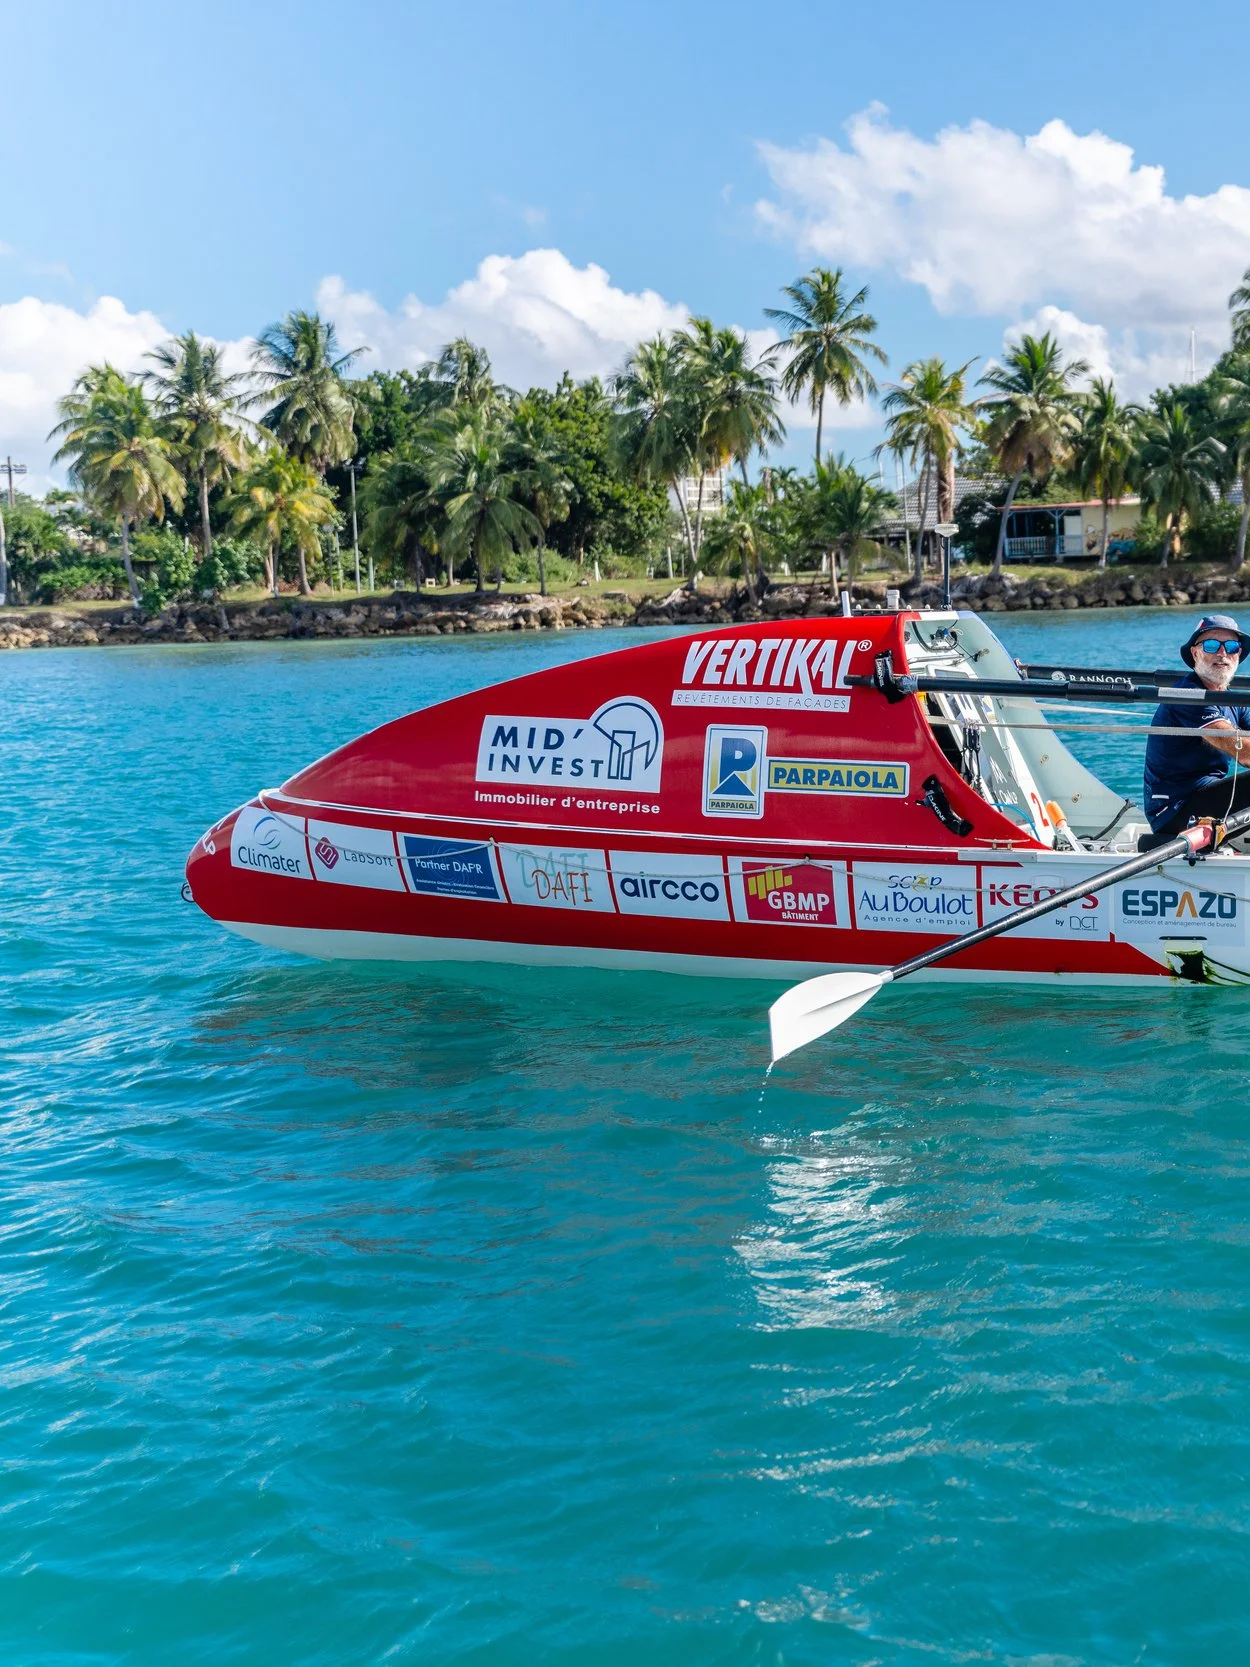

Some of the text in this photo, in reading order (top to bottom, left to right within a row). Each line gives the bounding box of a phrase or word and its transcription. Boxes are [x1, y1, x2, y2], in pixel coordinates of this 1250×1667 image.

[766, 696, 781, 706] DE
[788, 697, 846, 709] FAÇADES
[488, 753, 604, 778] INVEST
[773, 767, 899, 789] PARPAIOLA
[474, 790, 660, 814] Immobilier d'entreprise
[710, 801, 754, 810] PARPAIOLA
[238, 846, 301, 873] Climater
[415, 858, 451, 871] Partner
[531, 869, 594, 906] DAFI
[620, 871, 720, 902] aircco
[989, 883, 1099, 909] KEOS
[767, 891, 830, 912] GBMP
[1122, 889, 1237, 919] ESPAZO
[781, 910, 819, 921] BÂTIMENT
[863, 914, 971, 926] Agence d'emploi
[1055, 918, 1064, 927] by
[1122, 918, 1157, 927] Conception
[1157, 918, 1164, 926] et
[1164, 919, 1206, 928] aménagement
